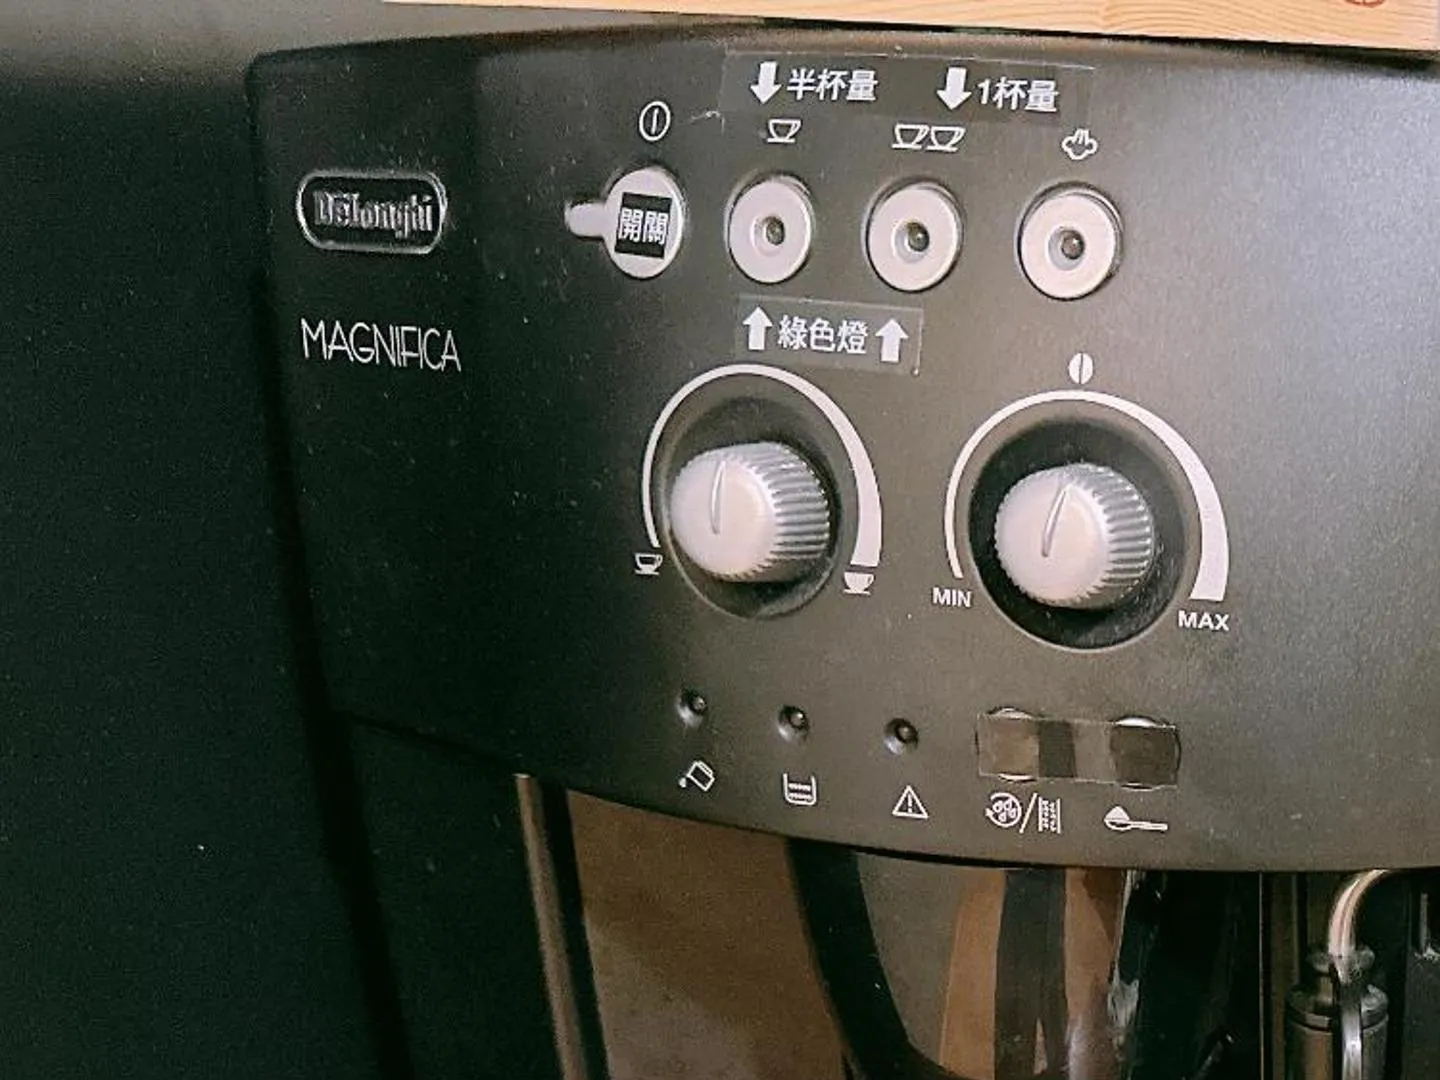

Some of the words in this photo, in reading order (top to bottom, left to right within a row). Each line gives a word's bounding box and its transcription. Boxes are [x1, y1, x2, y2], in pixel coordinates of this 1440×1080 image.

[787, 68, 878, 102] 半杯量
[978, 77, 1060, 113] 1杯量
[618, 207, 669, 245] 開關
[301, 317, 462, 372] MAGNIFICA
[777, 314, 869, 355] 綠色燈
[932, 586, 972, 608] MIN
[1177, 609, 1231, 632] MAX
